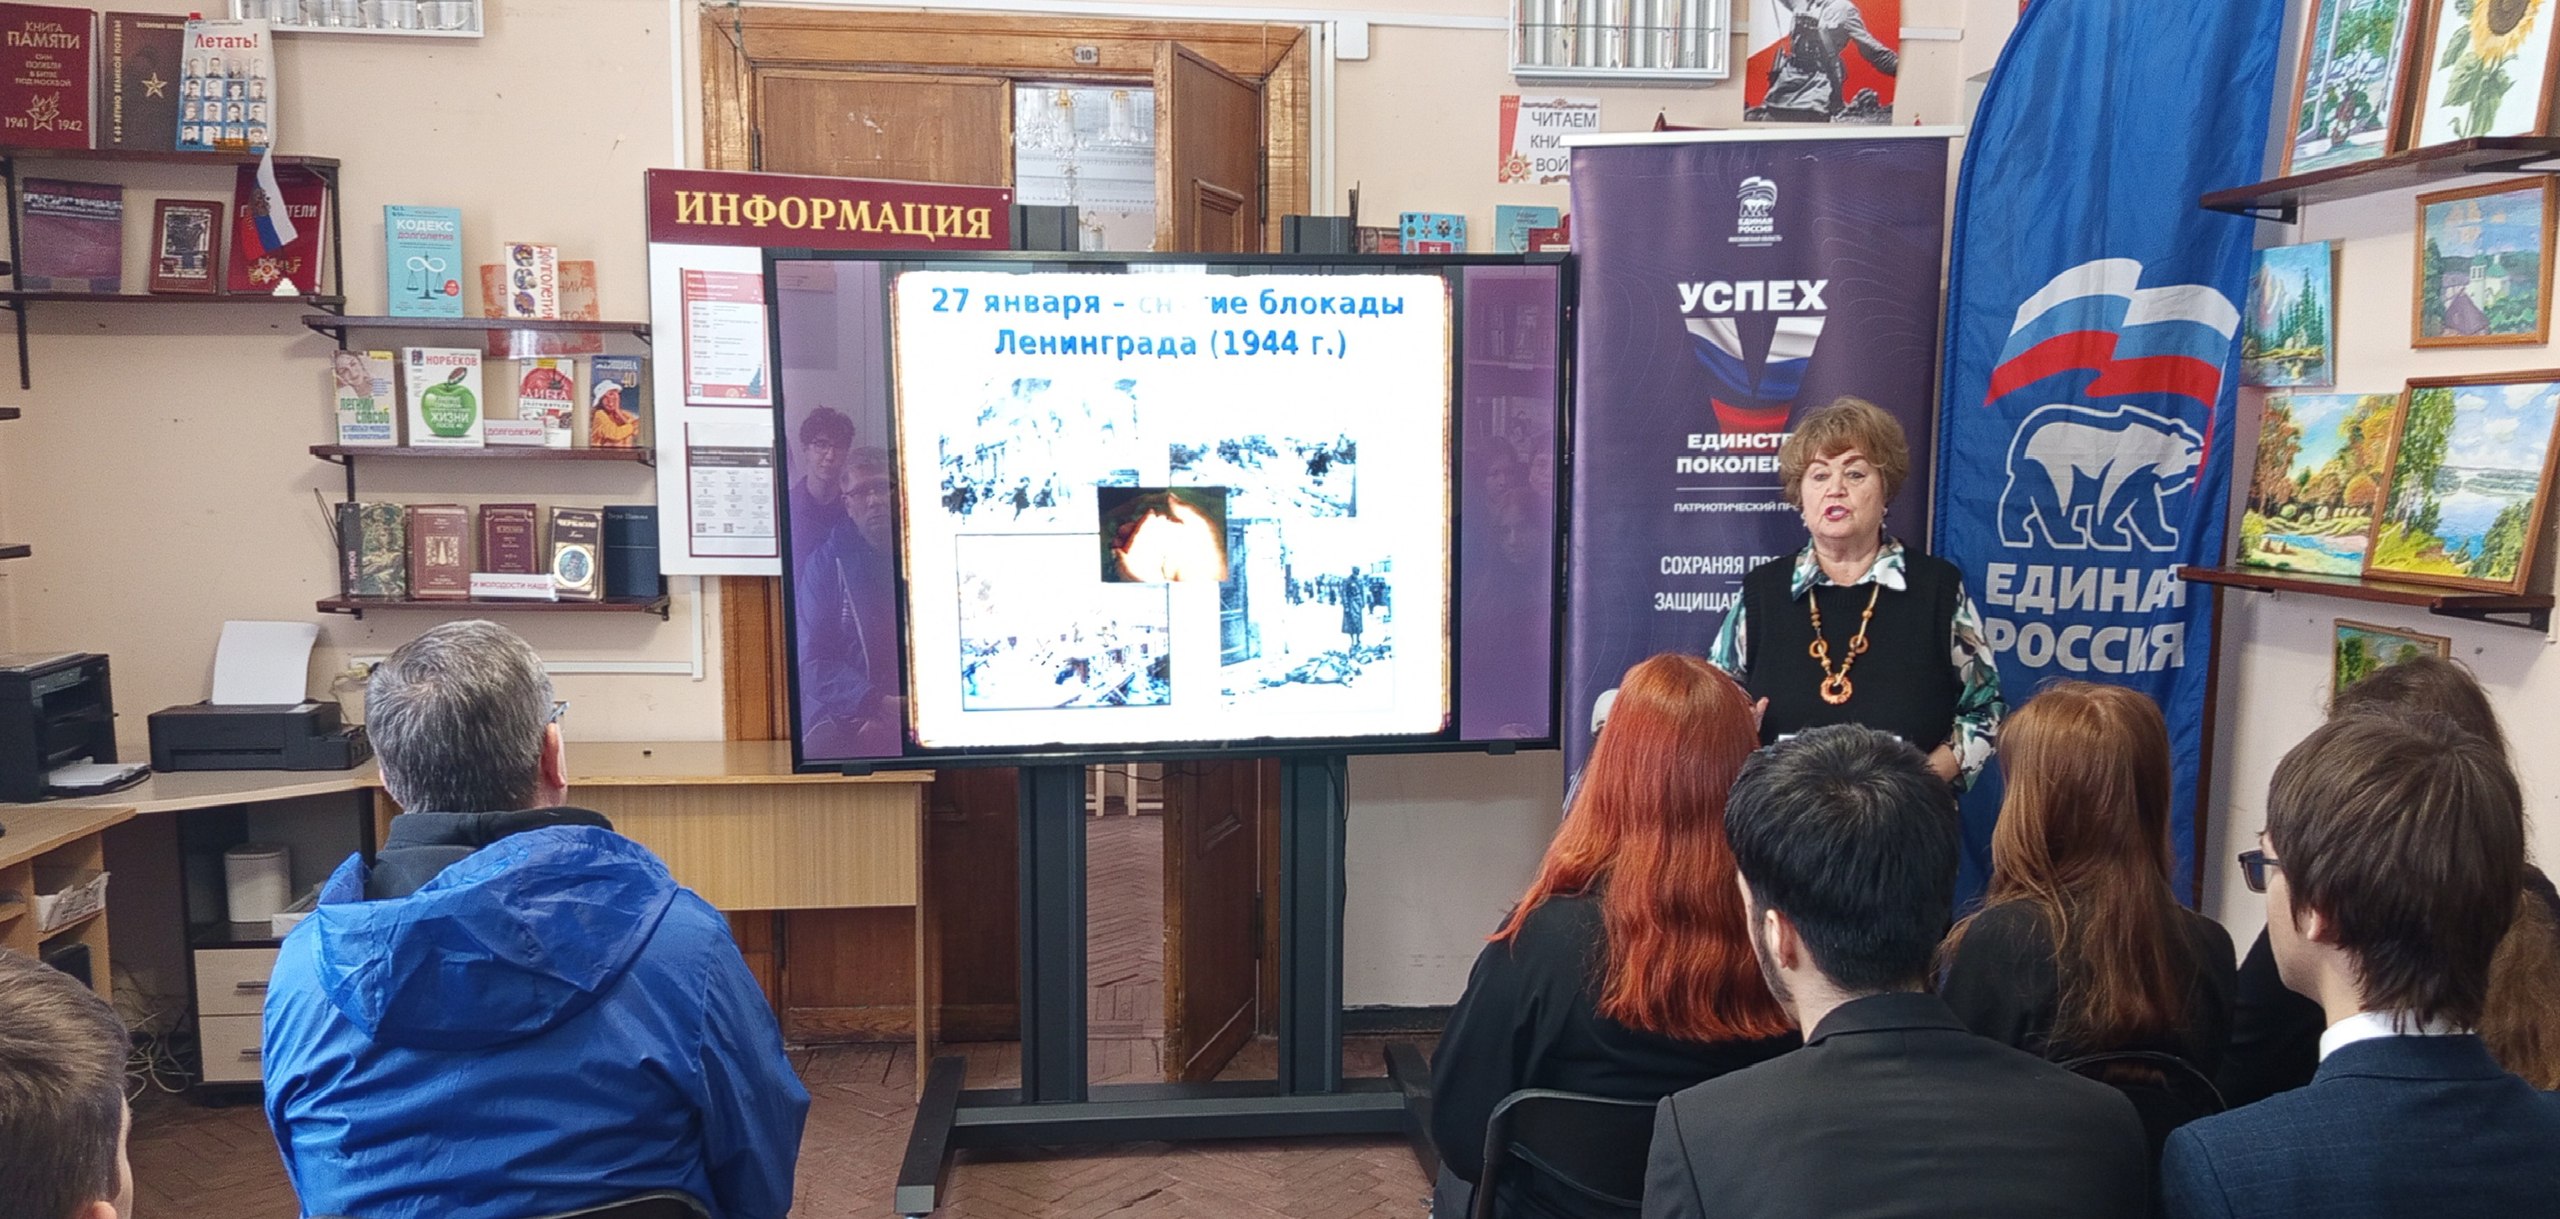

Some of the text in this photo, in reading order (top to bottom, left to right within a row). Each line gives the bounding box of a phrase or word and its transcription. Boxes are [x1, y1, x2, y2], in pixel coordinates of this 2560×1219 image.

[25, 21, 63, 33] КНИГА
[7, 31, 80, 50] ПАМЯТИ
[194, 33, 258, 49] Летать!
[1080, 50, 1093, 60] 10
[5, 116, 28, 129] 1941
[58, 119, 83, 132] 1942
[1531, 111, 1596, 128] ЧИТАЕМ
[1530, 134, 1561, 149] КНИ
[1536, 156, 1569, 173] ВОЙ
[675, 190, 993, 242] ИНФОРМАЦИЯ
[1737, 217, 1774, 226] ЕДИНАЯ
[396, 219, 455, 232] КОДЕКС
[1737, 225, 1774, 234] РОССИЯ
[932, 287, 969, 313] 27
[984, 295, 1100, 320] января
[1259, 288, 1404, 318] блокады
[1677, 279, 1829, 314] УСПЕХ
[995, 329, 1346, 361] Ленинграда (1944 г.)
[426, 355, 478, 366] НОРБЕКОВ
[430, 411, 470, 424] ЖИЗНИ
[1673, 501, 1776, 513] ПАТРИОТИЧЕСКИЙ
[1660, 555, 1745, 575] СОХРАНЯЯ
[1985, 562, 2189, 615] ЕДИНАЯ
